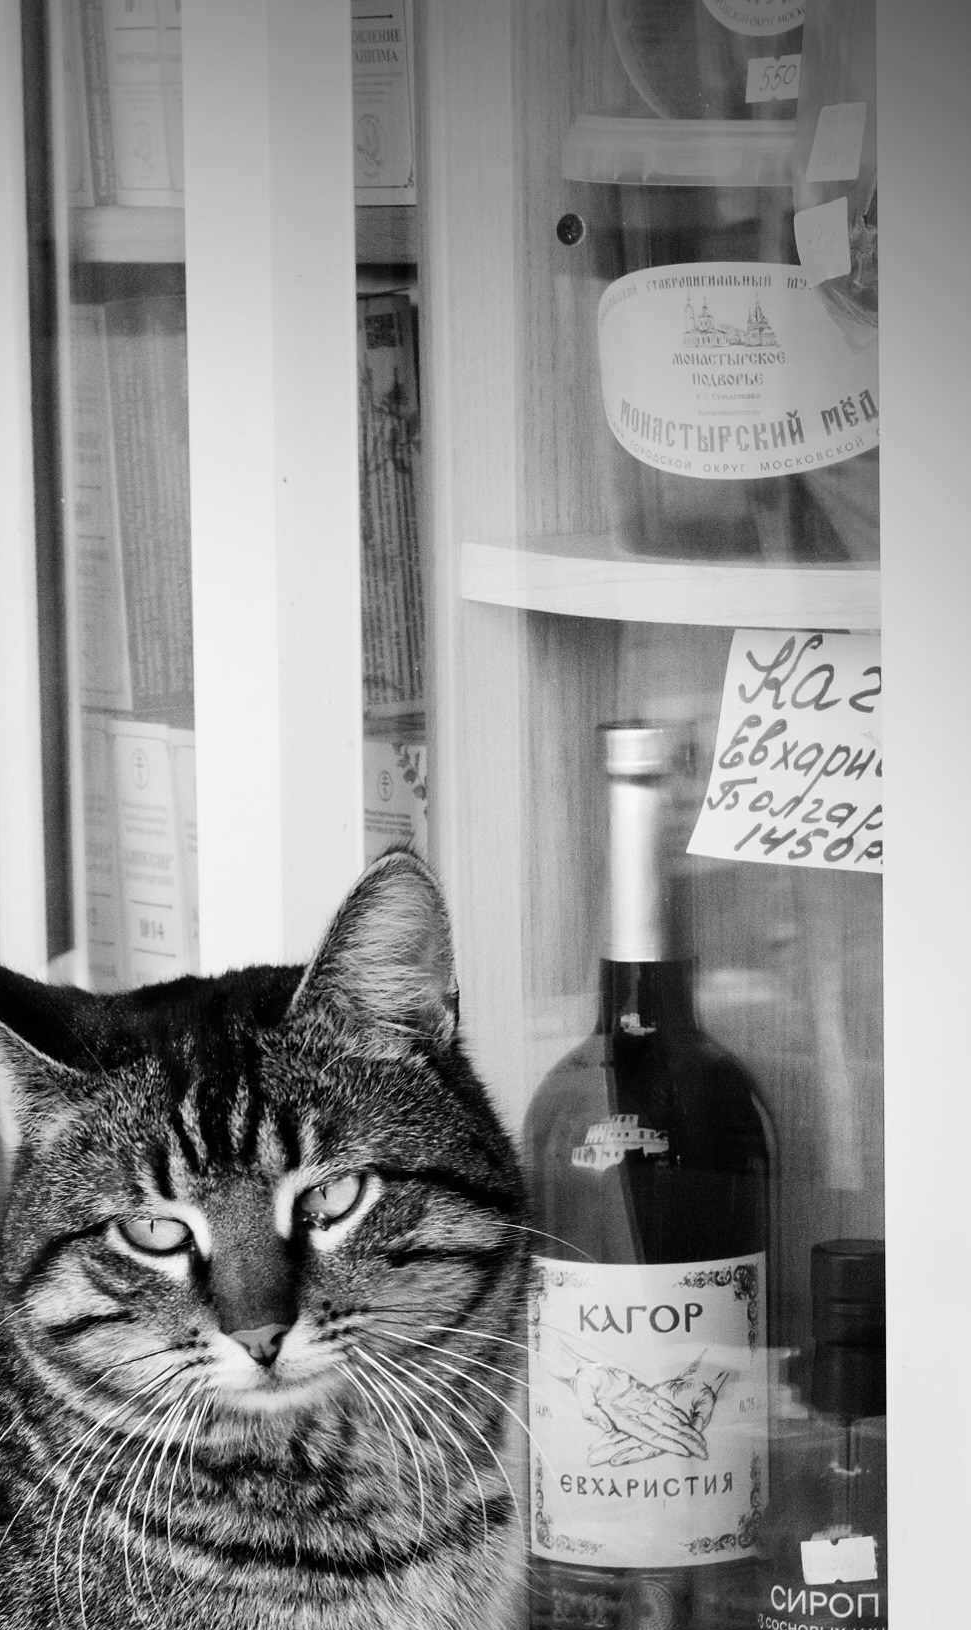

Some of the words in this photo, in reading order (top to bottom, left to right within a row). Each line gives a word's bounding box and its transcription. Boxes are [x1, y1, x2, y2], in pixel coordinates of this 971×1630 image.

[759, 65, 797, 91] 550
[621, 398, 806, 453] МОНАСТЫРСКИЙ
[702, 462, 746, 474] ОКРУГ
[759, 436, 865, 472] МОСКОВСКОЙ
[578, 1302, 703, 1334] КАГОР
[770, 1584, 879, 1619] СИРОП
